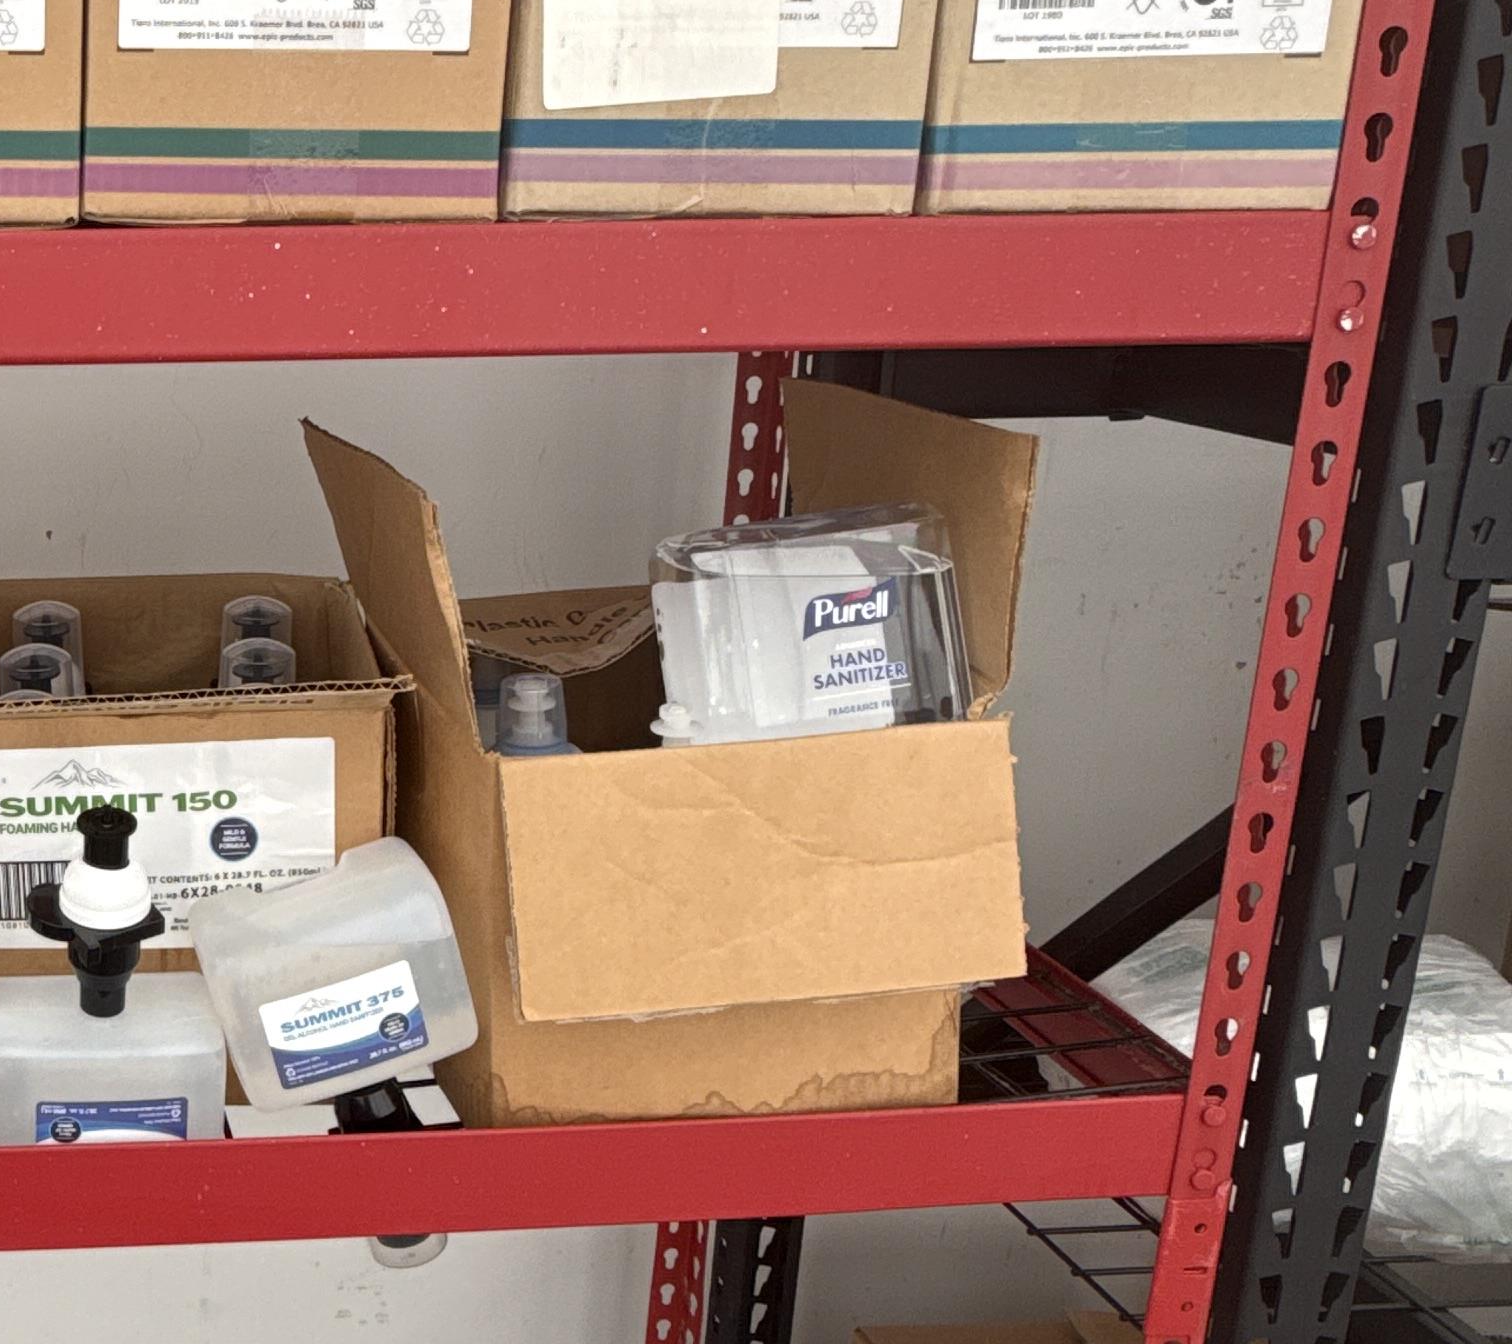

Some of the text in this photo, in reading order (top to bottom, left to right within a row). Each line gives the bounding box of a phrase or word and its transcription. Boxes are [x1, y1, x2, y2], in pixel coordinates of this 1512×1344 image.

[1212, 7, 1232, 18] SGS
[813, 590, 889, 628] Purell
[830, 648, 885, 669] HAND
[814, 663, 906, 690] SANITIZER
[0, 790, 237, 818] SUMMIT 150
[0, 823, 58, 835] FOAMING
[160, 873, 213, 884] CONTENTS:
[280, 1000, 362, 1034] SUMMIT
[367, 986, 404, 1007] 375
